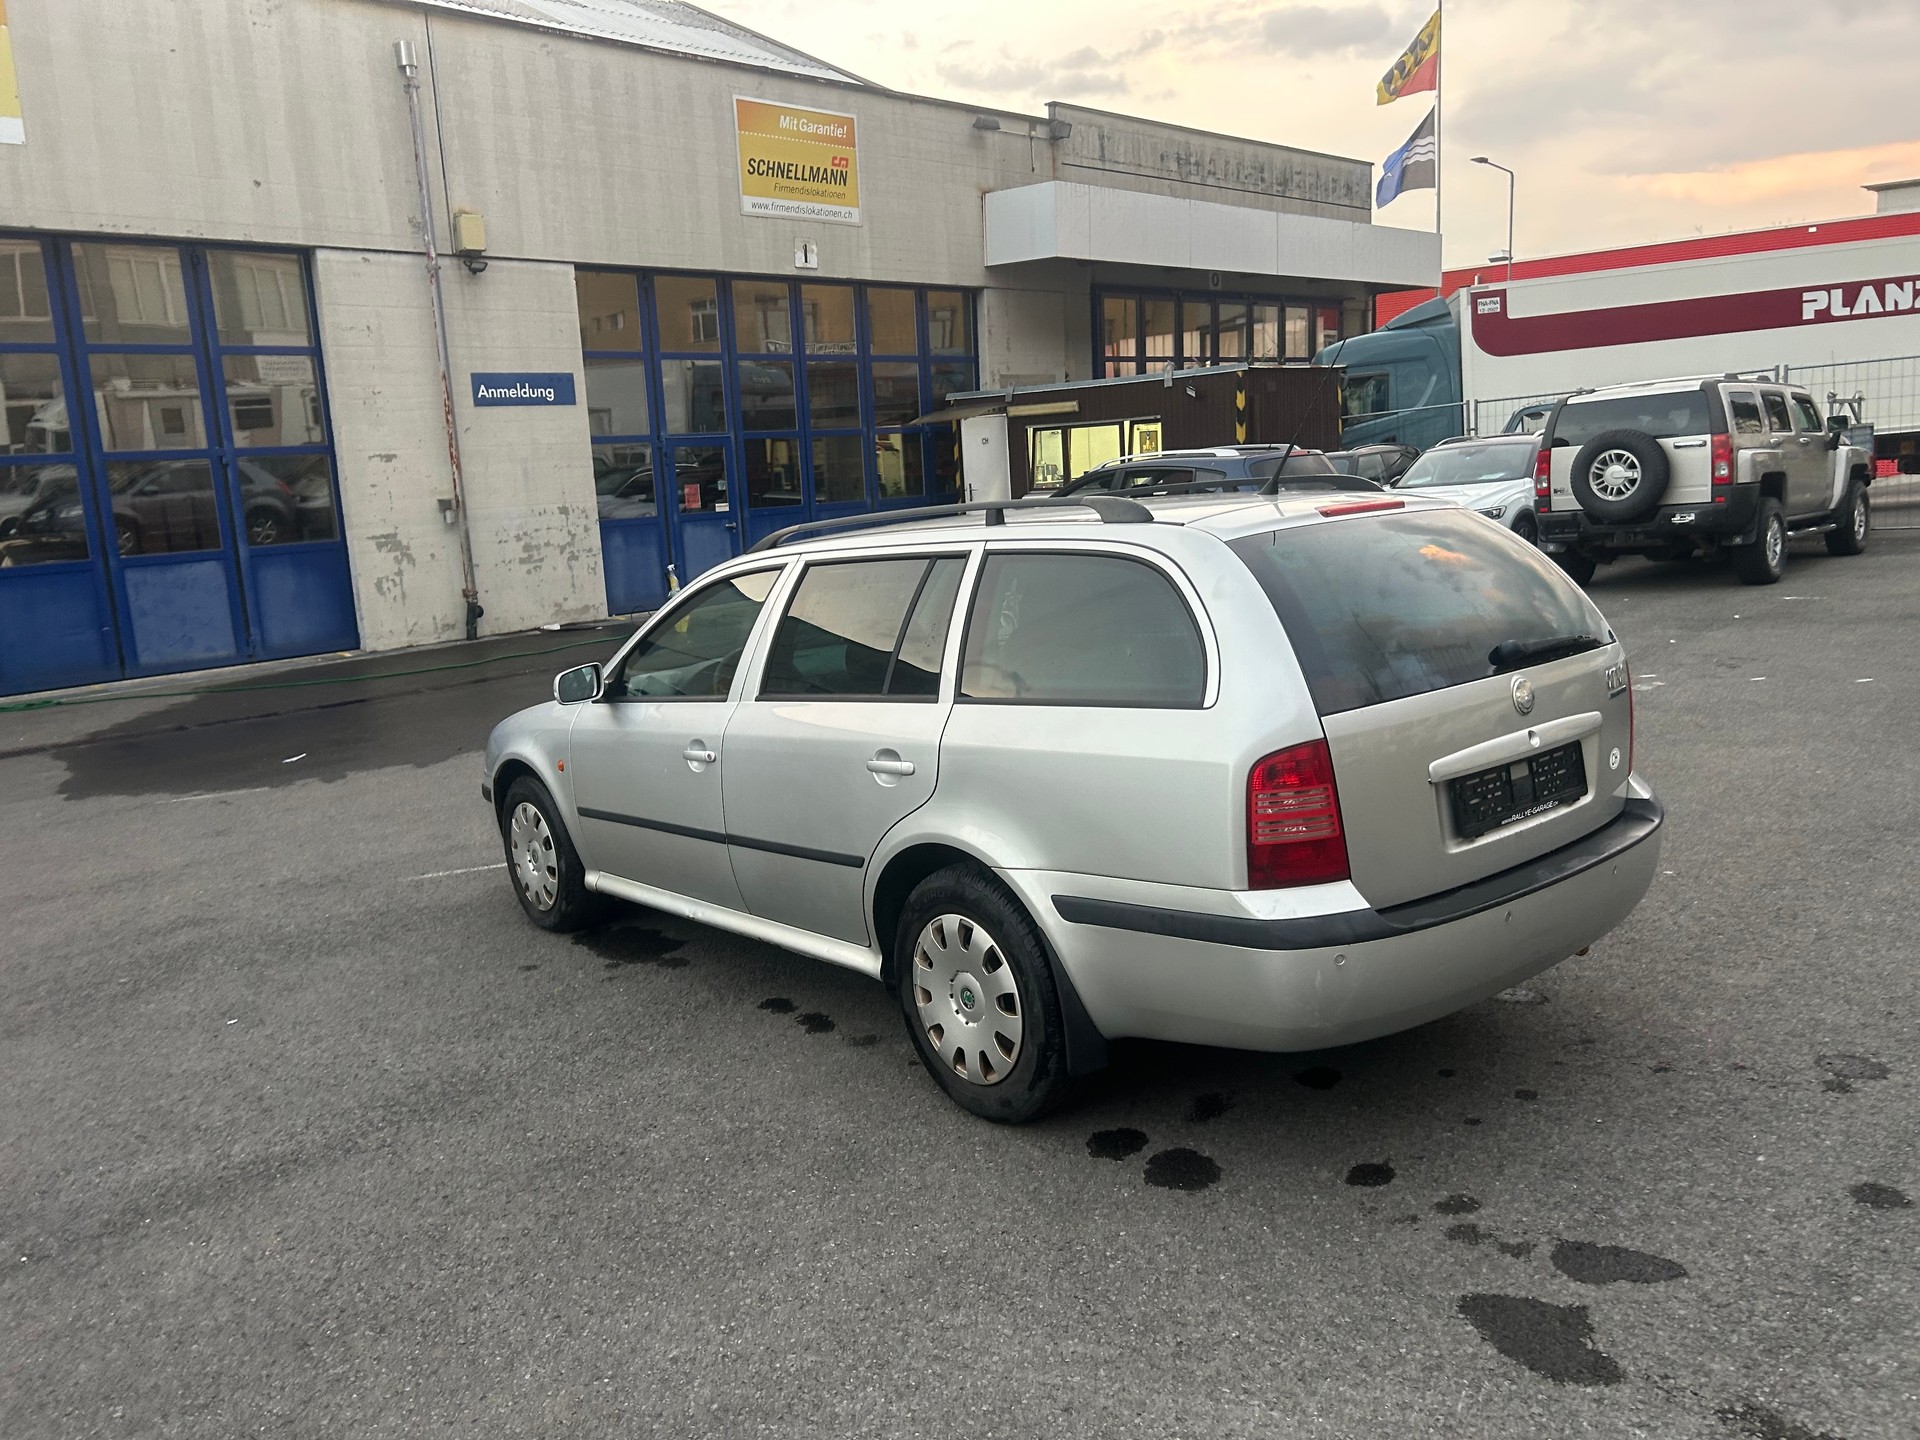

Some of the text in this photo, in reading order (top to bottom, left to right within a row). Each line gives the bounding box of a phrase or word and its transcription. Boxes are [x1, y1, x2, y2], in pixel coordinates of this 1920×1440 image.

[779, 115, 848, 138] Mit Garantie!
[747, 157, 848, 187] SCHNELLMANN
[773, 182, 846, 199] Firmendislokationen
[751, 201, 853, 219] www.firmendislokationen.ch
[1802, 280, 1920, 320] PLAN
[477, 382, 555, 402] Anmeldung
